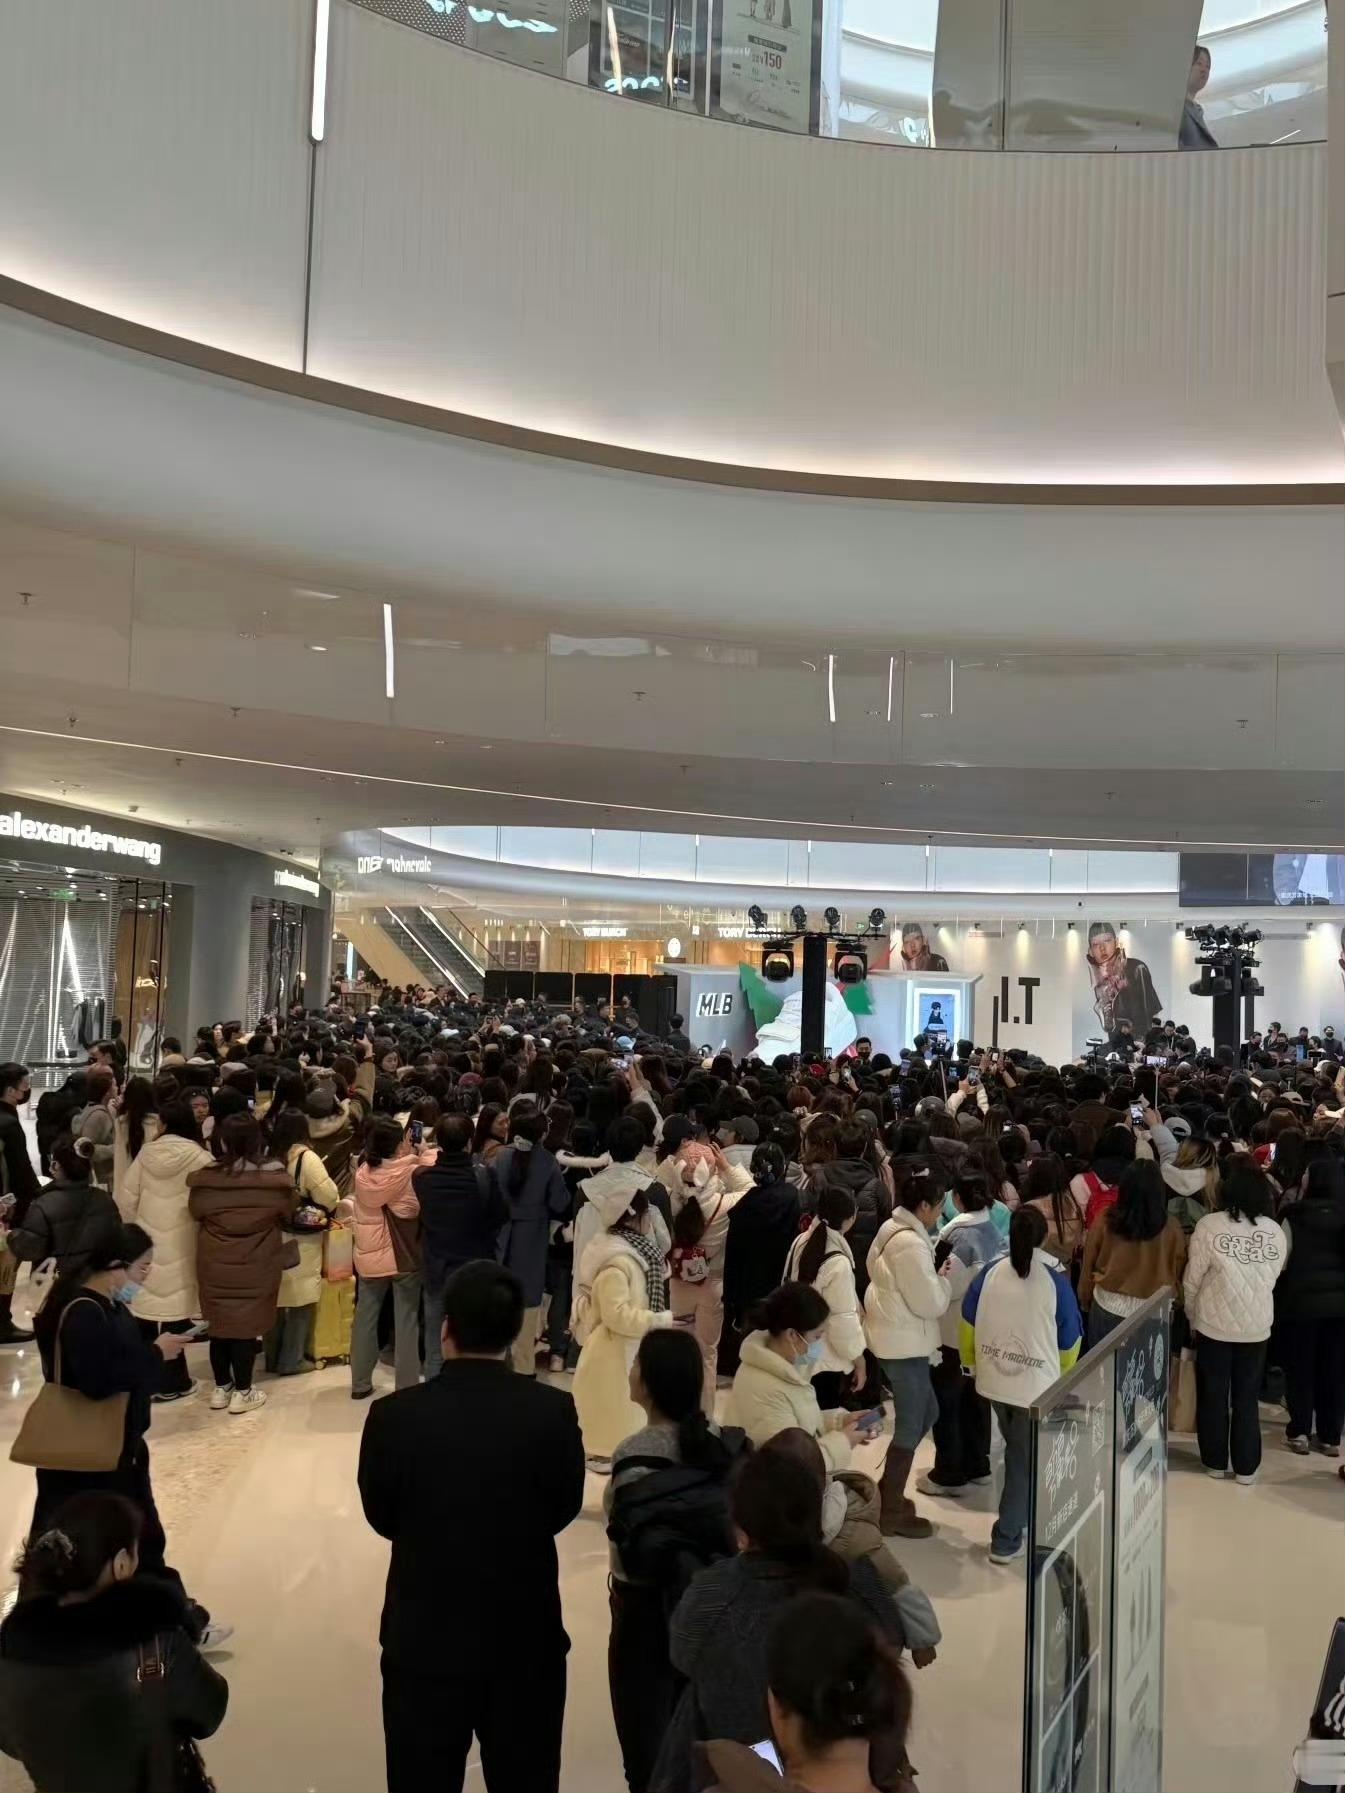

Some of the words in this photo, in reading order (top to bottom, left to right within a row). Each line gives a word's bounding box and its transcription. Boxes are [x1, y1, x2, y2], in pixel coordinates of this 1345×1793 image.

[0, 811, 161, 865] alexanderwang
[718, 927, 744, 937] TORY
[697, 992, 733, 1017] MLB
[981, 1344, 1001, 1358] TIME
[1002, 1350, 1046, 1369] MACHINE
